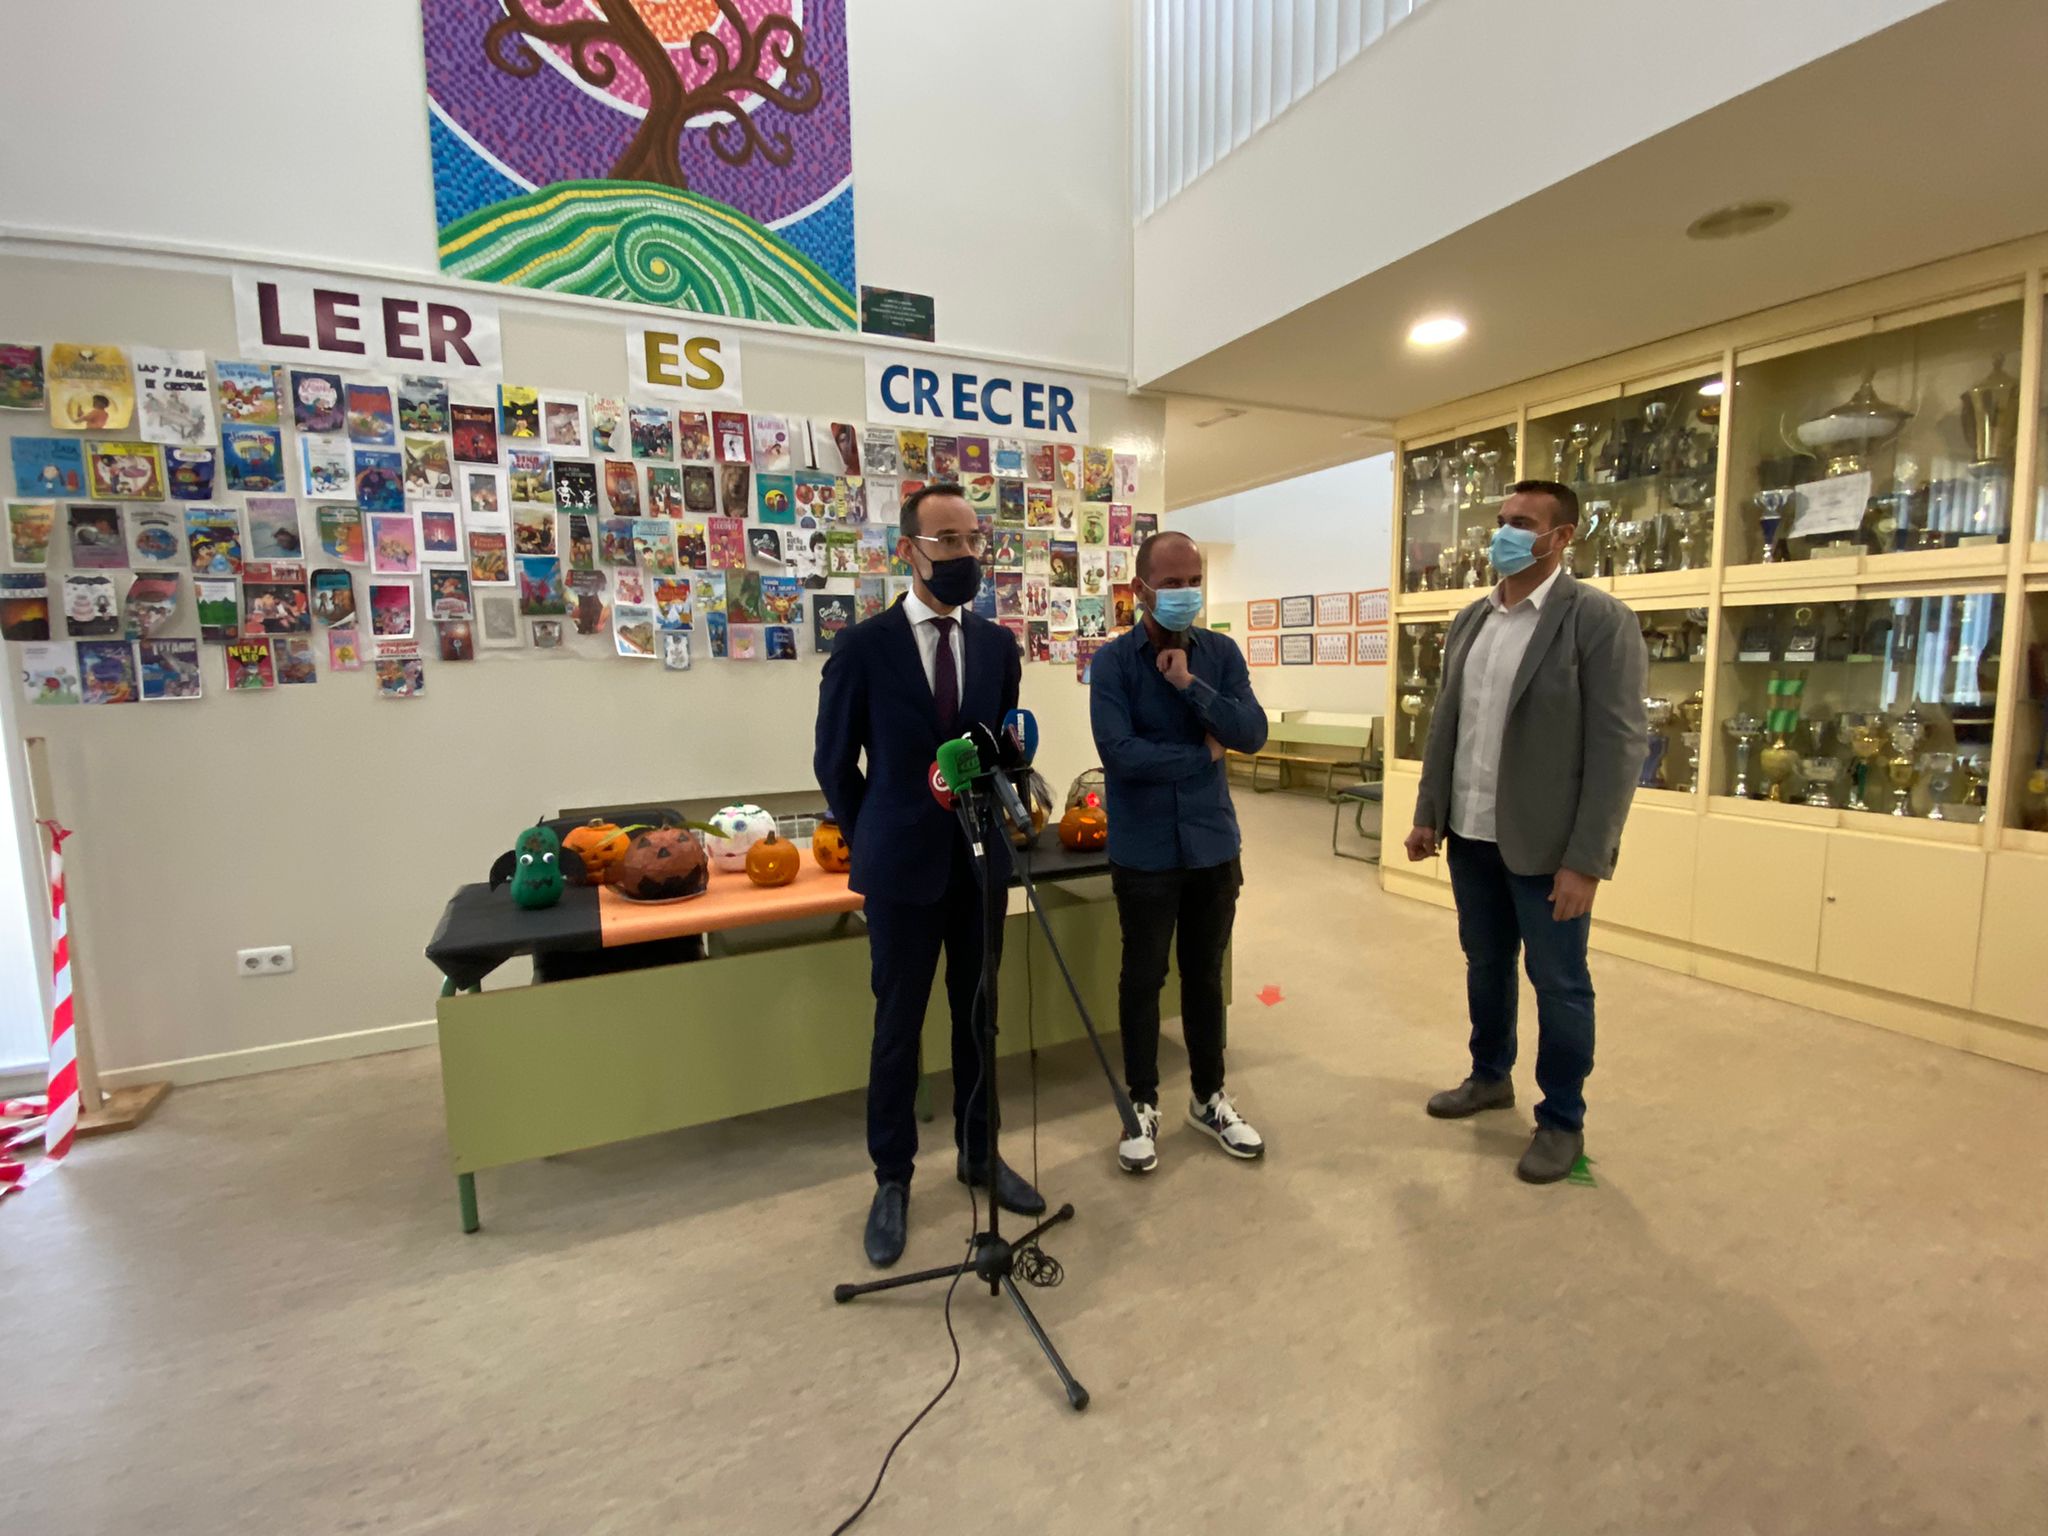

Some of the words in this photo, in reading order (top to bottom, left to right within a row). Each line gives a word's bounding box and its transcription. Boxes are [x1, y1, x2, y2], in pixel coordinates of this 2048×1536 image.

[257, 282, 480, 366] LEER
[138, 364, 159, 373] LAS
[163, 367, 171, 377] 7
[644, 330, 725, 390] ES
[880, 364, 1077, 433] CRECER
[228, 646, 268, 656] NINJA
